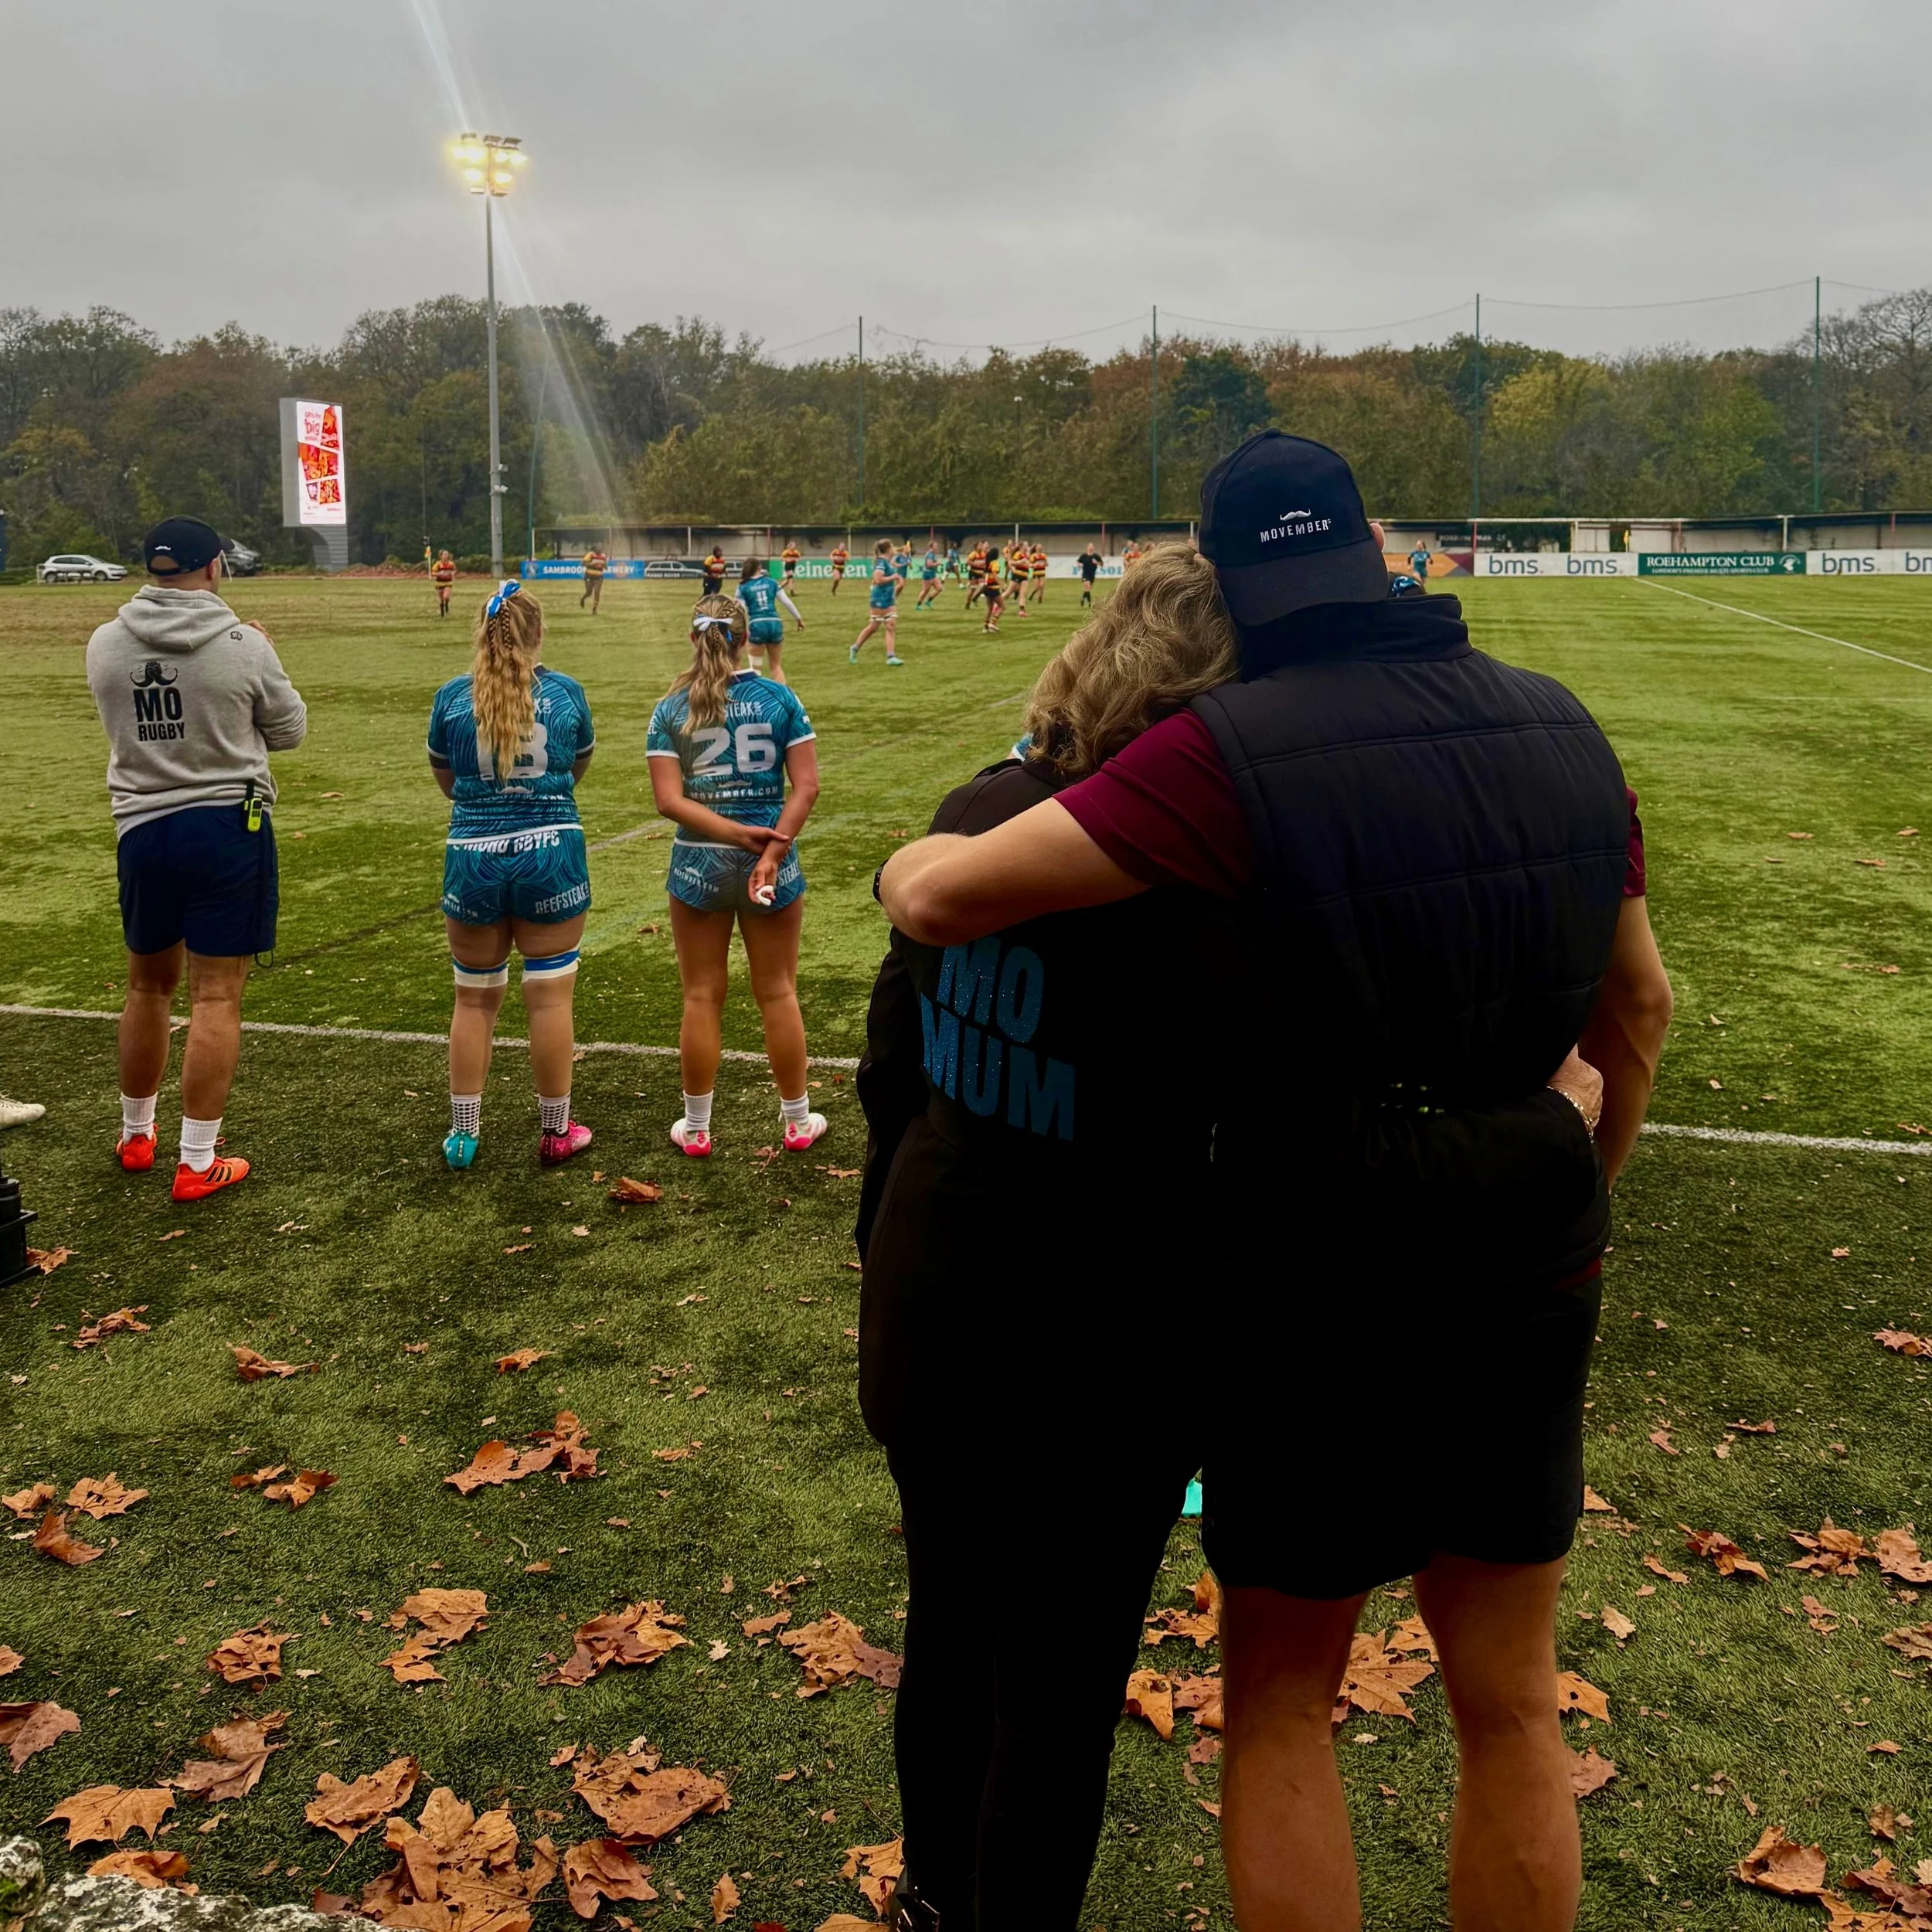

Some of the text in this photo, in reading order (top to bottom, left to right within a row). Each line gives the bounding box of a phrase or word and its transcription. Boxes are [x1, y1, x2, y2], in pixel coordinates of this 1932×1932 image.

[1647, 556, 1736, 567] ROEHAMPTON
[1740, 556, 1774, 566] CLUB
[133, 687, 183, 723] MO
[138, 722, 185, 742] RUGBY
[692, 723, 777, 776] 26
[936, 935, 1044, 1043] MO
[920, 991, 1076, 1141] MUM
